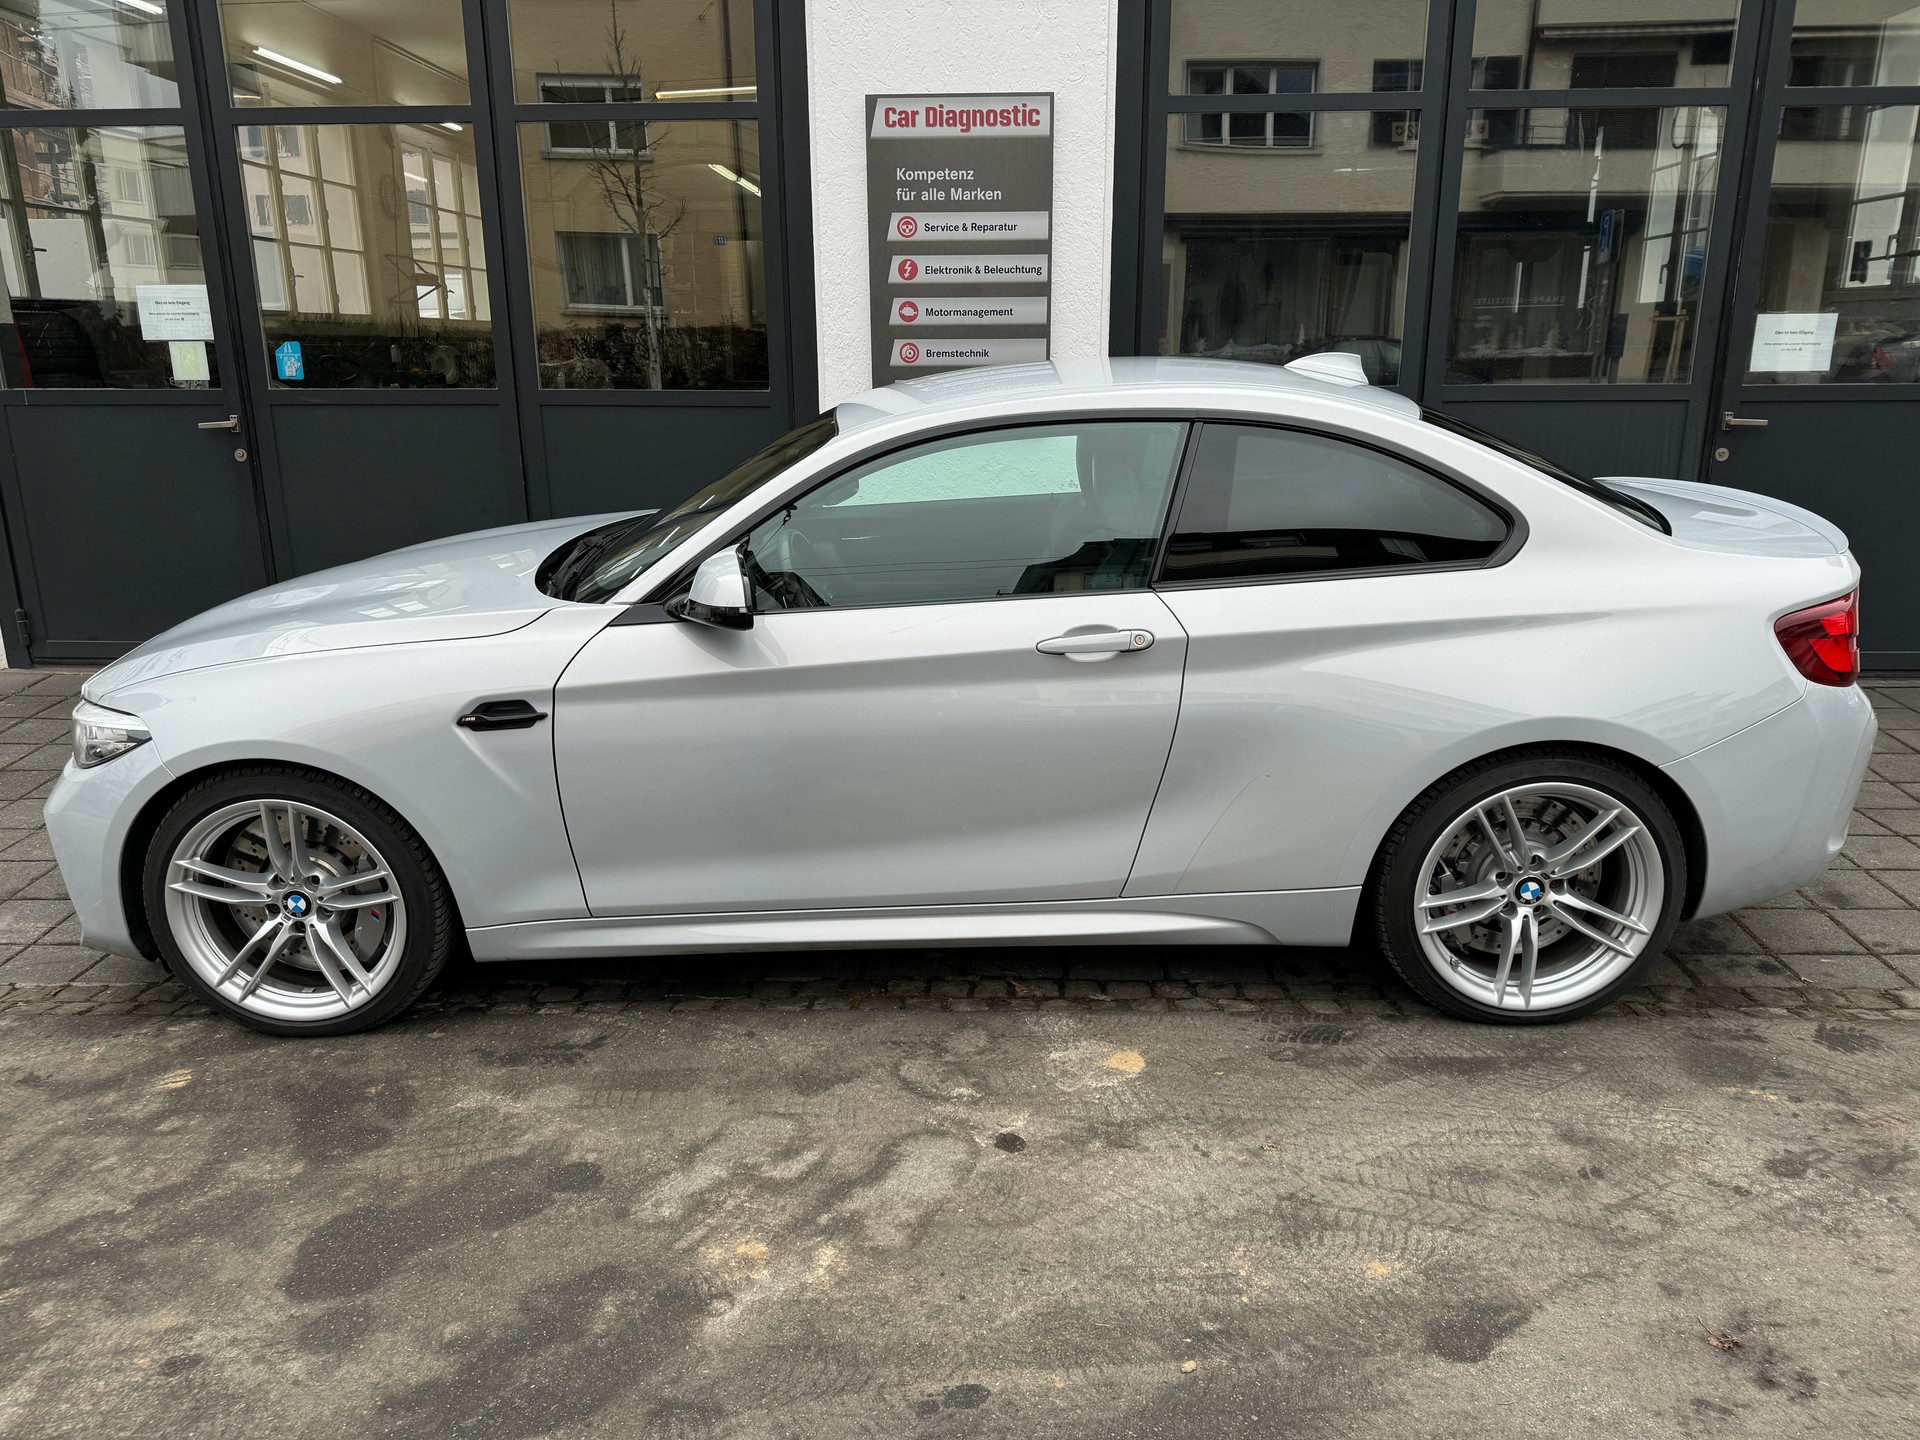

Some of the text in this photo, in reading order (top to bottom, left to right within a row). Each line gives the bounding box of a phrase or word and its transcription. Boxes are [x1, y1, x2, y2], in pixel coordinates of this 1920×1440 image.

[884, 103, 1041, 133] Car Diagnostic
[896, 168, 974, 184] Kompetenz
[896, 187, 1002, 201] für alle Marken
[924, 222, 1018, 234] Service & Reparatur
[925, 265, 1042, 276] Elektronik & Beleuchtung
[925, 307, 1014, 319] Motormanagement
[926, 349, 990, 358] Bremstechnik
